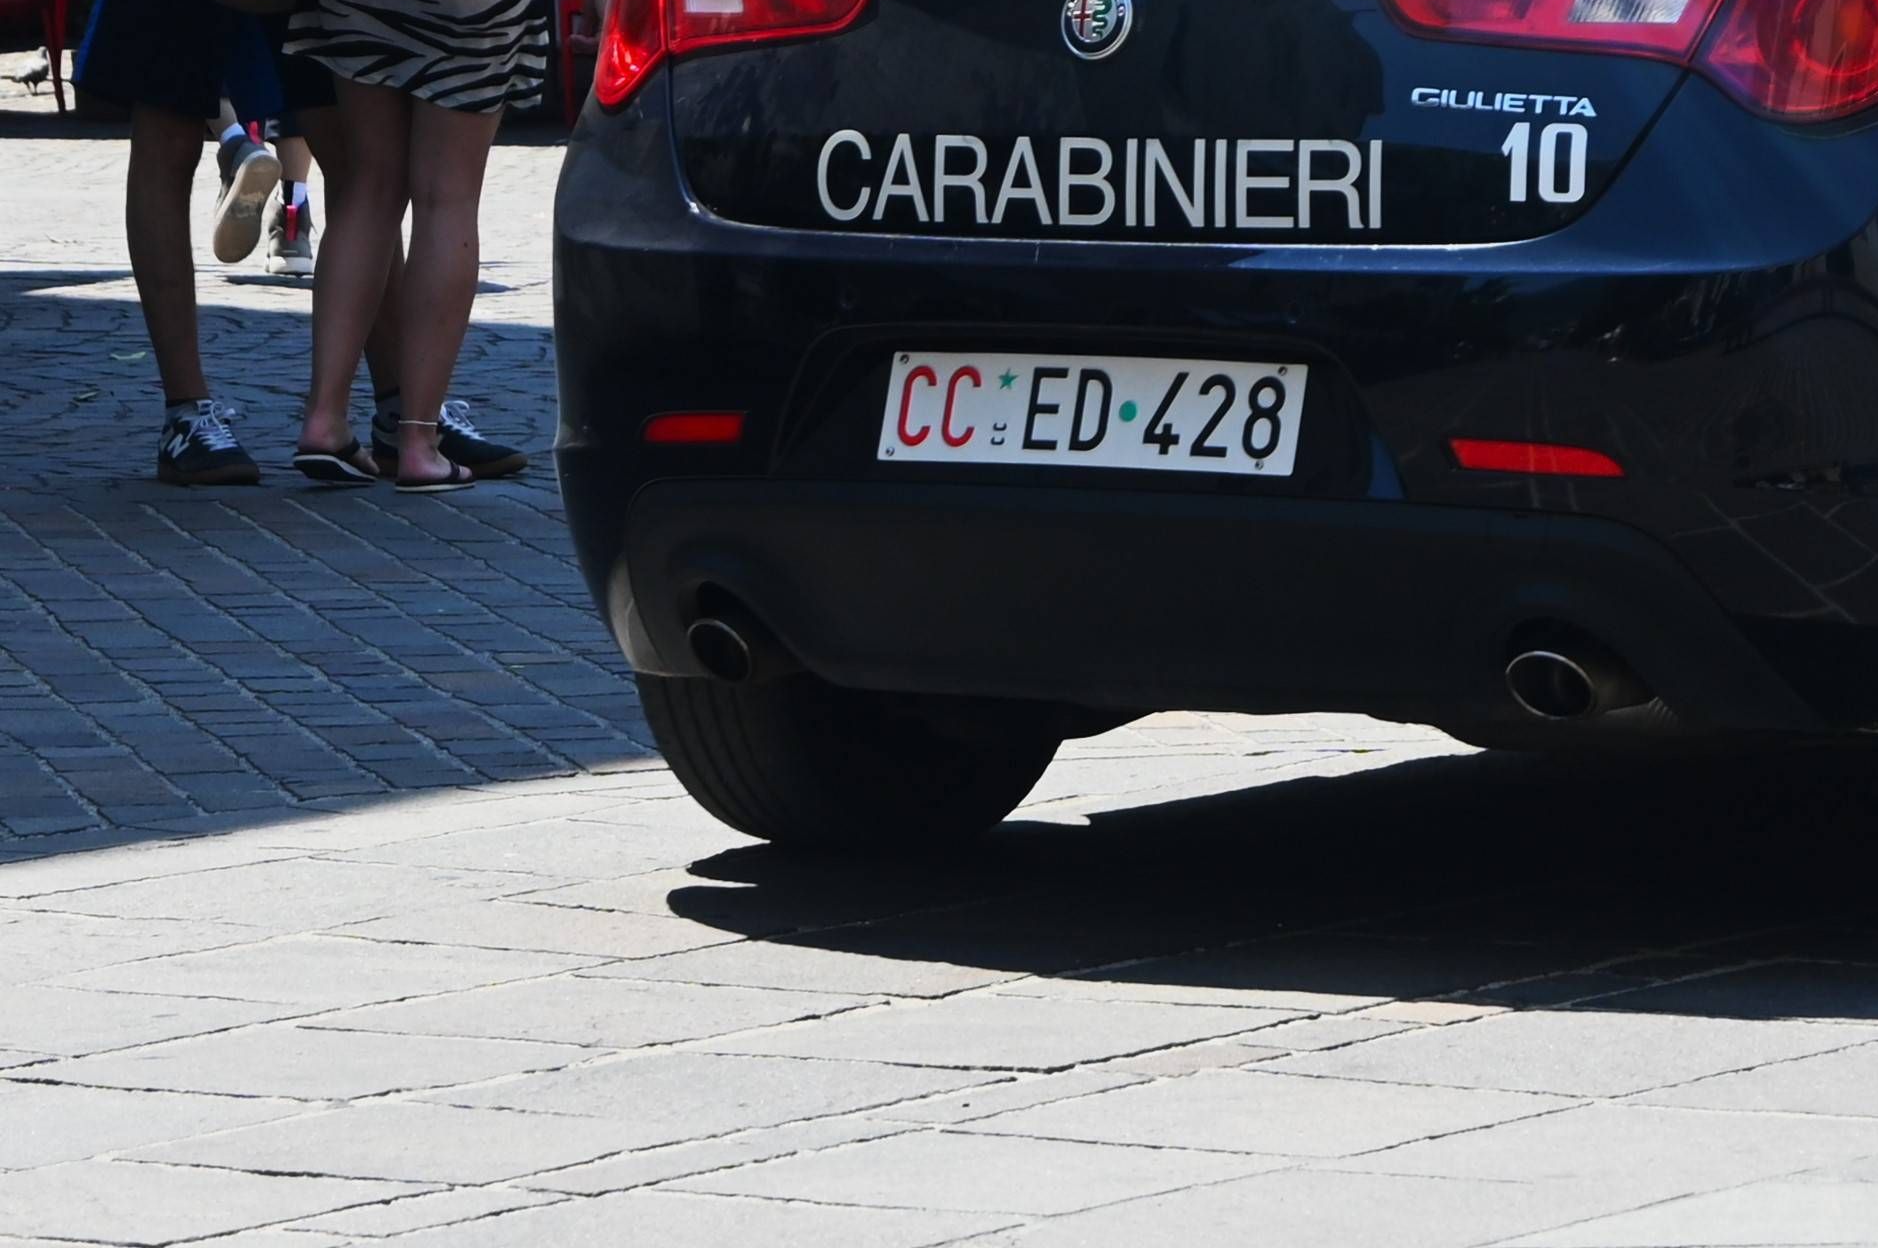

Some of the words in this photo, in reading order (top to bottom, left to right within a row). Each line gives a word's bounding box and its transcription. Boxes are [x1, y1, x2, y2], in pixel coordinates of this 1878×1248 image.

[1411, 87, 1597, 117] GIULIETTA
[815, 129, 1383, 230] CARABINIERI
[1501, 122, 1588, 203] 10
[897, 365, 982, 448] CC
